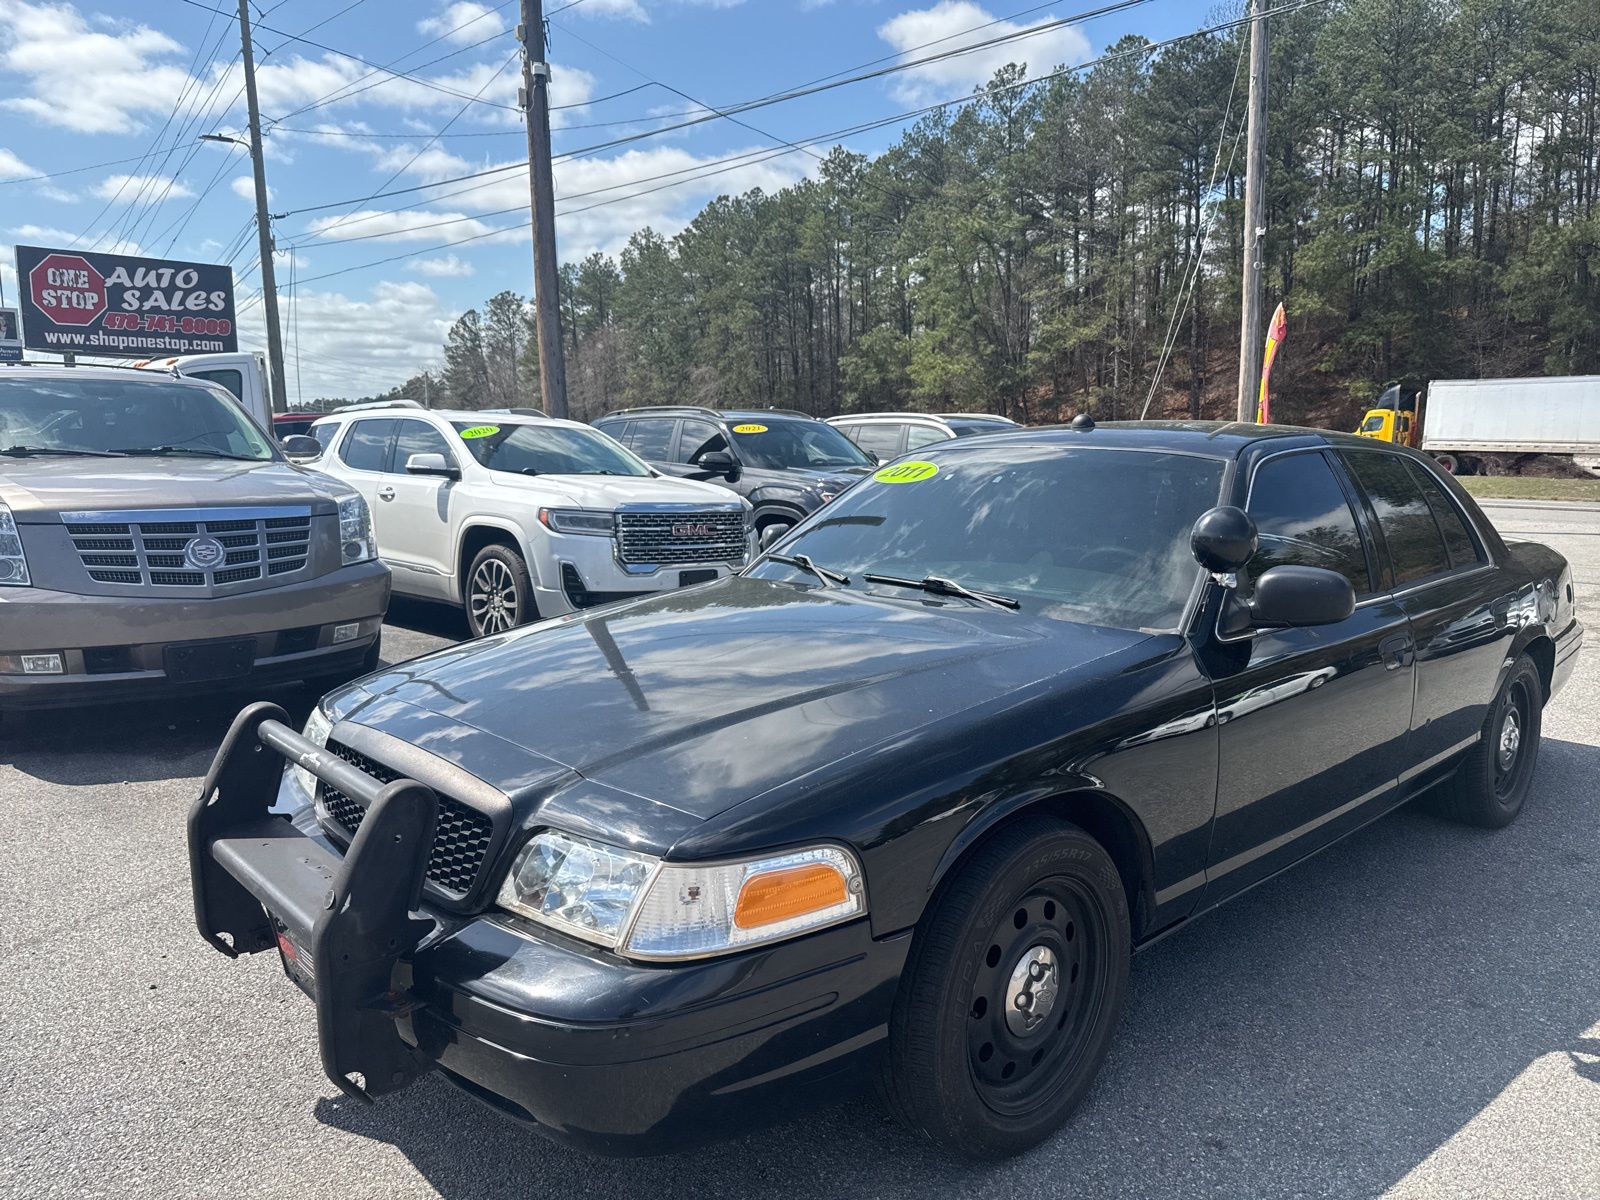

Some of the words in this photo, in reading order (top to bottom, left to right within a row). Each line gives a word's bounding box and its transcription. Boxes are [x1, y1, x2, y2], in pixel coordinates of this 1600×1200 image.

[47, 267, 90, 289] ONE
[104, 266, 199, 289] AUTO
[41, 289, 99, 310] STOP
[44, 330, 224, 352] www.shoponestop.com
[469, 426, 494, 437] 2020
[877, 466, 933, 479] 2011
[672, 523, 719, 537] GMC
